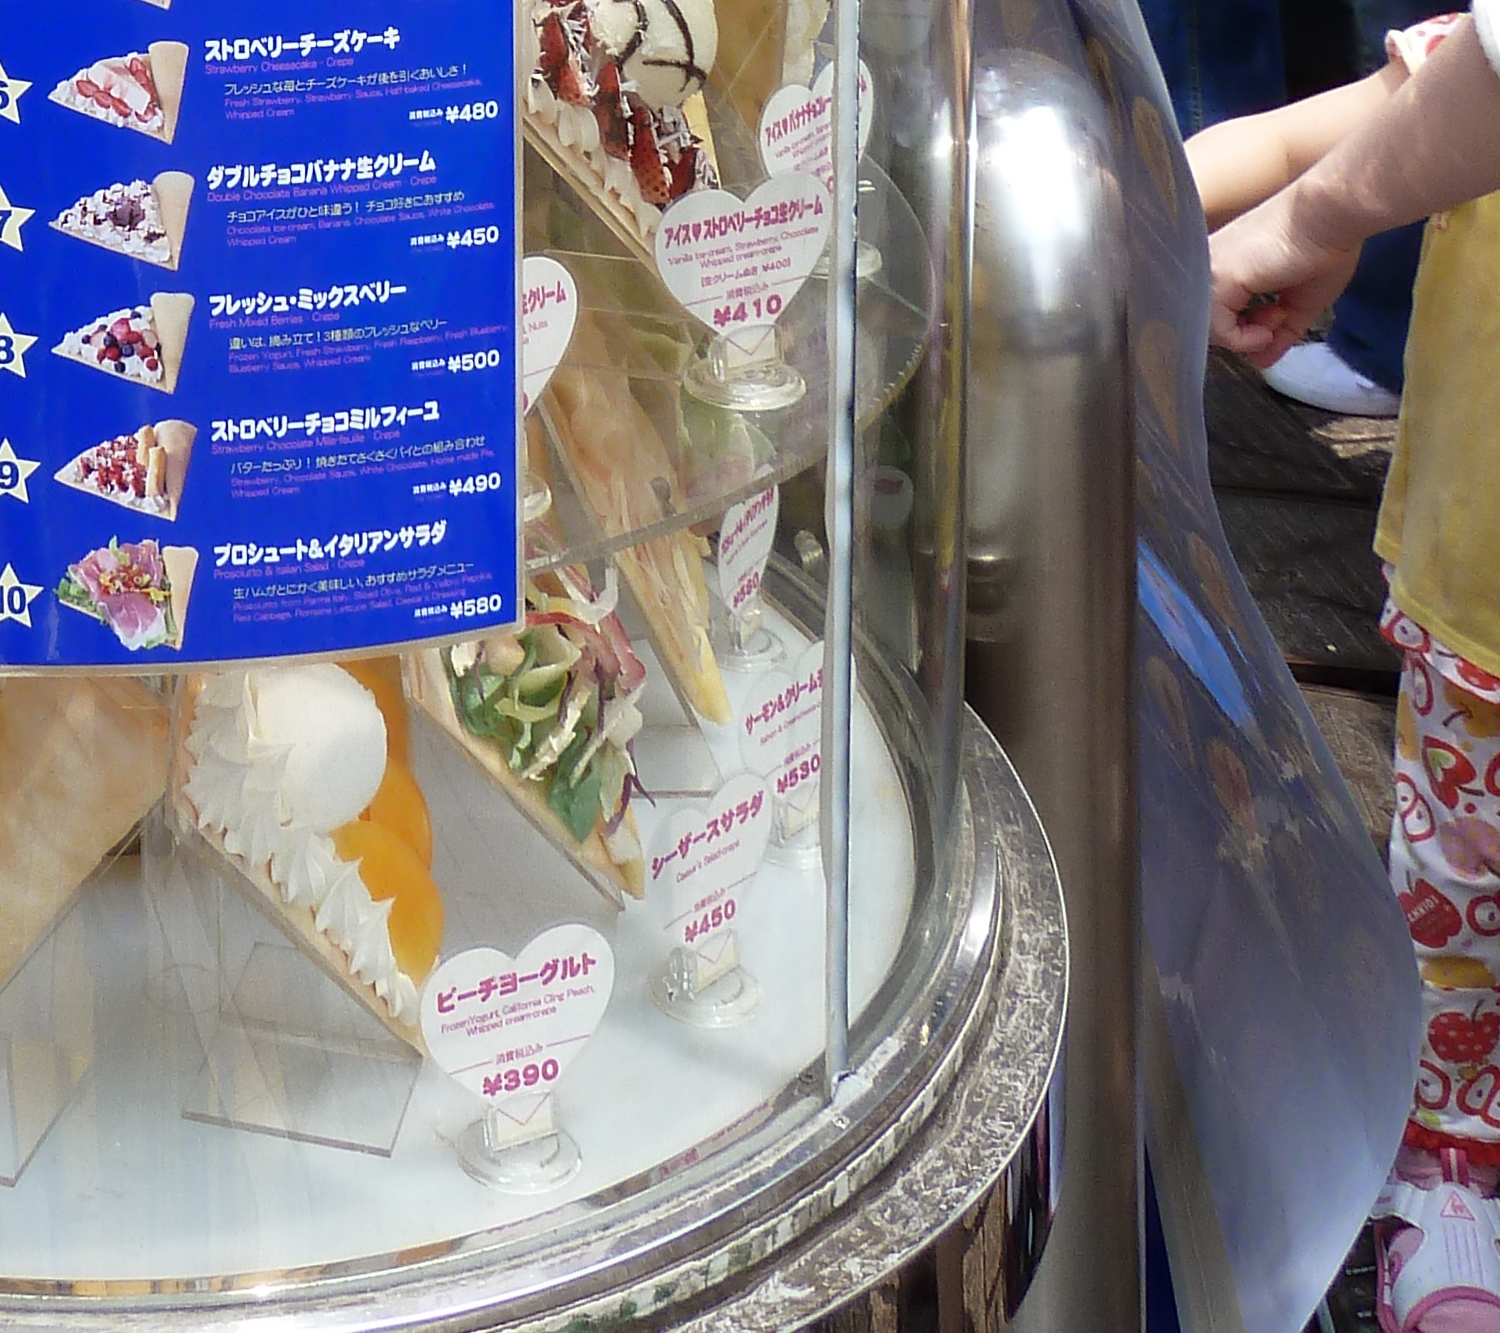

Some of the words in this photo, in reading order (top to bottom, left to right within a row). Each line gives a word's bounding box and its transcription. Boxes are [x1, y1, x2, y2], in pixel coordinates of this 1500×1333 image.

[204, 26, 401, 63] ストロベリーチーズケーキ
[445, 101, 499, 124] ¥480
[206, 150, 437, 191] ダブルチョコバナナ生クリーム
[446, 225, 500, 249] ¥450
[208, 280, 408, 317] フレッシュ・ミックスベリー
[713, 293, 783, 329] ¥410
[447, 349, 501, 373] ¥500
[211, 400, 440, 443] ストロベリーチョコミルフィーユ
[448, 471, 502, 497] ¥490
[213, 519, 448, 567] プロシュート&イタリアンサラダ
[449, 594, 503, 620] ¥580
[732, 571, 760, 609] ¥580
[776, 753, 821, 795] ¥530
[651, 788, 764, 882] シーザースサラダ
[683, 898, 737, 944] ¥450
[543, 991, 565, 1007] Cling
[466, 1019, 504, 1038] Whipped
[482, 1058, 560, 1097] ¥390
